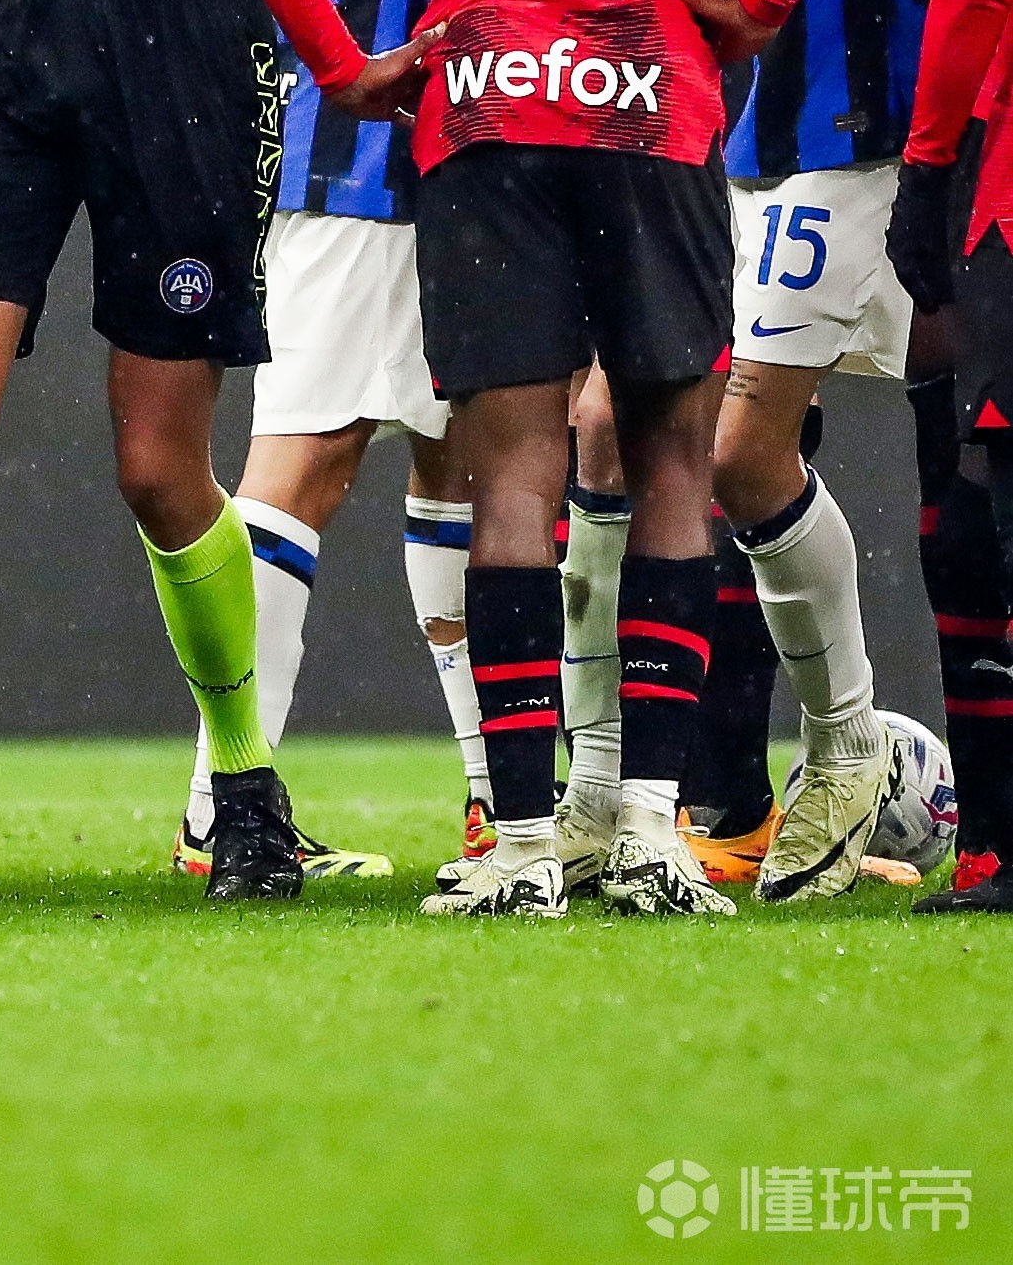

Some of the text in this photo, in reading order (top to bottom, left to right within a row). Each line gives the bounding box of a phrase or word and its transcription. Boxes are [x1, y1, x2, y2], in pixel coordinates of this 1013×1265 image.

[445, 37, 663, 113] wefox
[169, 273, 204, 294] AIA
[762, 204, 831, 291] 15
